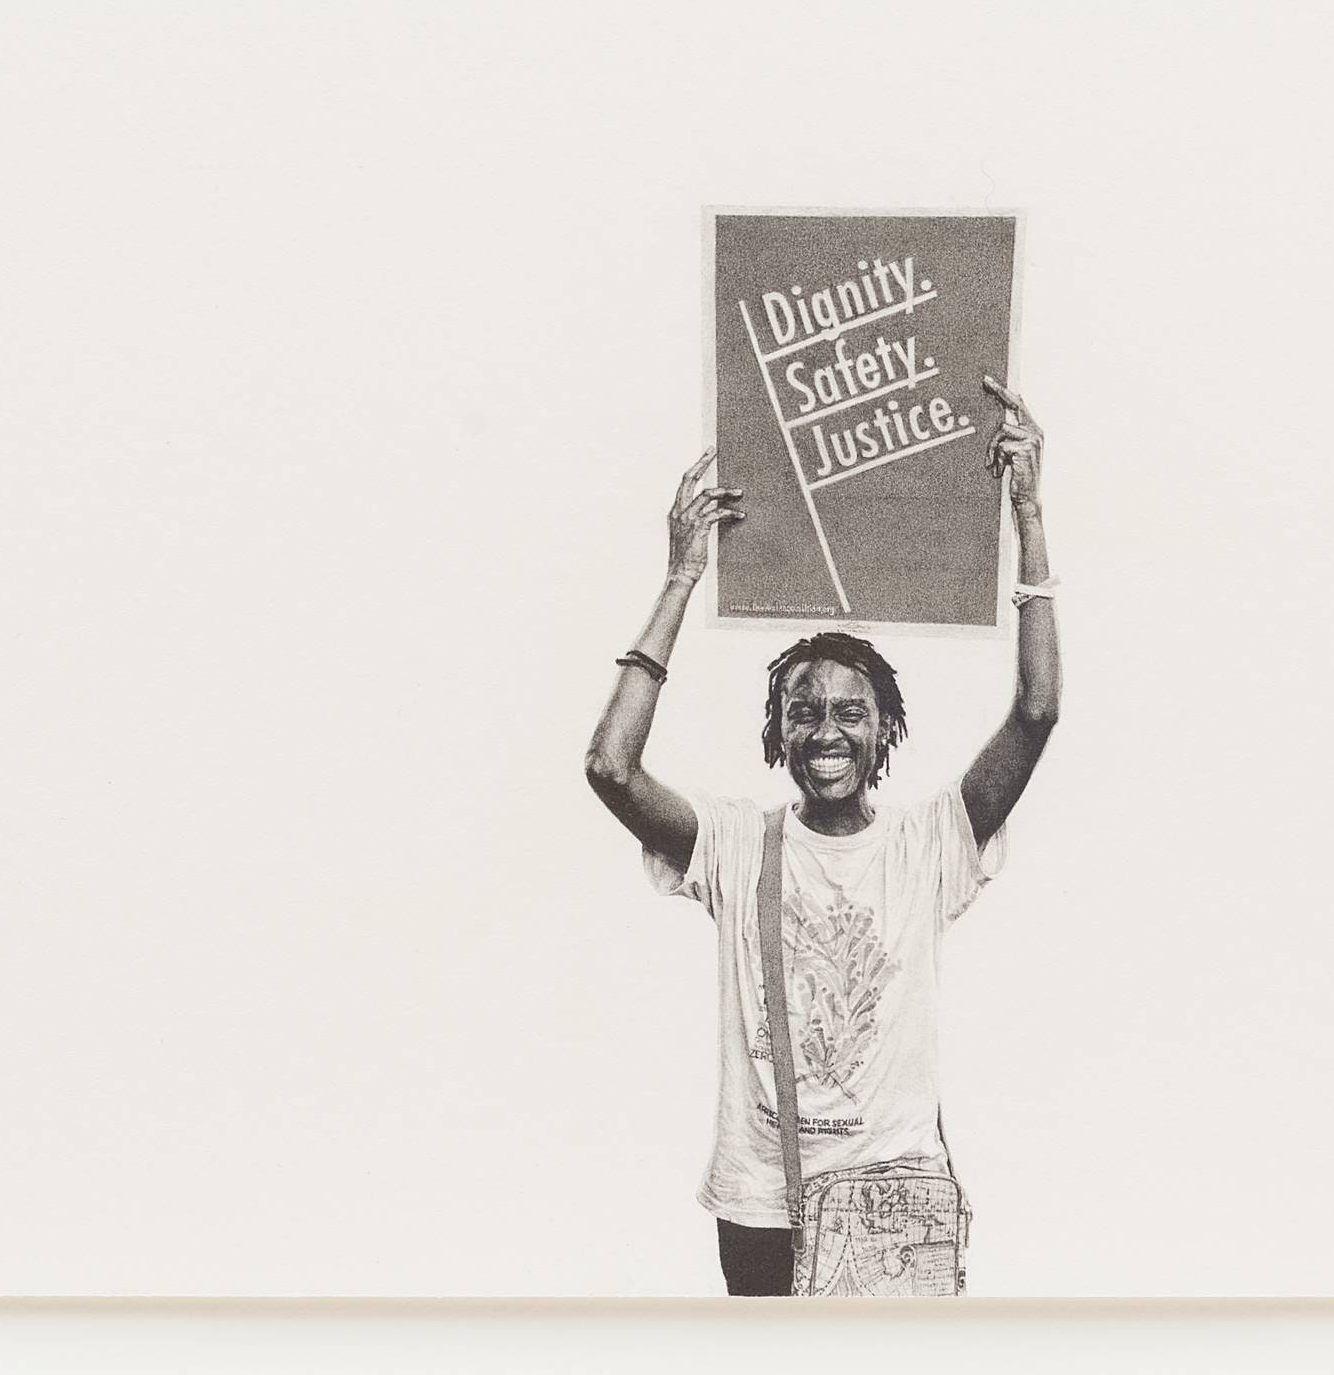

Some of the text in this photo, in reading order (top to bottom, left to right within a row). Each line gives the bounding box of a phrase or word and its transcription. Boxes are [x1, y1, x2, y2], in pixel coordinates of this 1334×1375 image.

[762, 257, 932, 345] Dignity.
[787, 336, 935, 413] Safety.
[811, 397, 969, 476] Justice.
[798, 1126, 816, 1135] AND
[812, 1117, 831, 1127] FOR
[832, 1116, 864, 1127] SEXUAL
